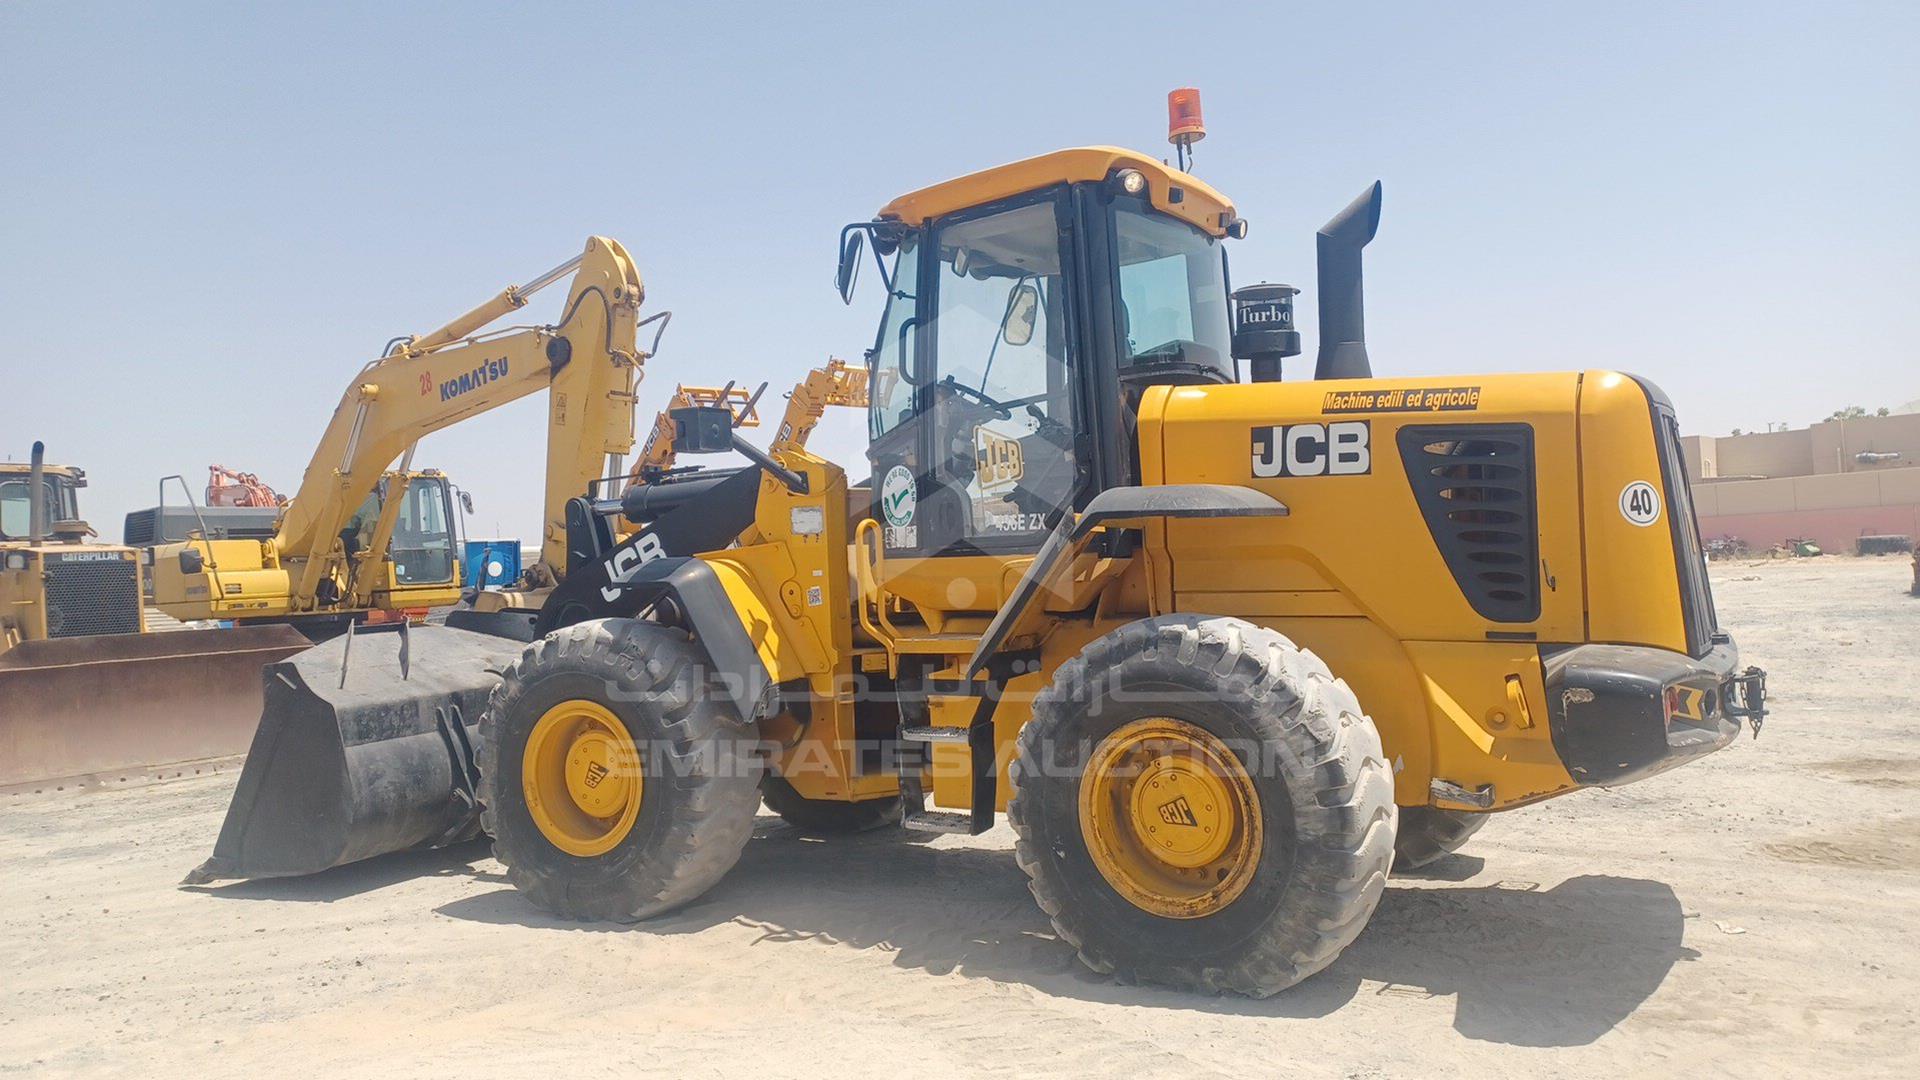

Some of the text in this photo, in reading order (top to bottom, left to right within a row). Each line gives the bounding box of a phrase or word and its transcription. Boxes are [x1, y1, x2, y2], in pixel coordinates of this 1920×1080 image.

[1240, 305, 1290, 324] Turbo
[419, 371, 433, 396] 28
[439, 356, 509, 402] KOMATSU
[1323, 387, 1479, 412] Machine edili ed agricole
[981, 433, 1019, 483] JCB
[1252, 421, 1370, 478] JCB
[1630, 488, 1652, 516] 40
[1029, 513, 1047, 530] ZX
[61, 552, 119, 562] CATERPILLAR
[600, 532, 668, 602] JCB
[585, 762, 606, 788] JCB
[1160, 798, 1195, 825] JCB
